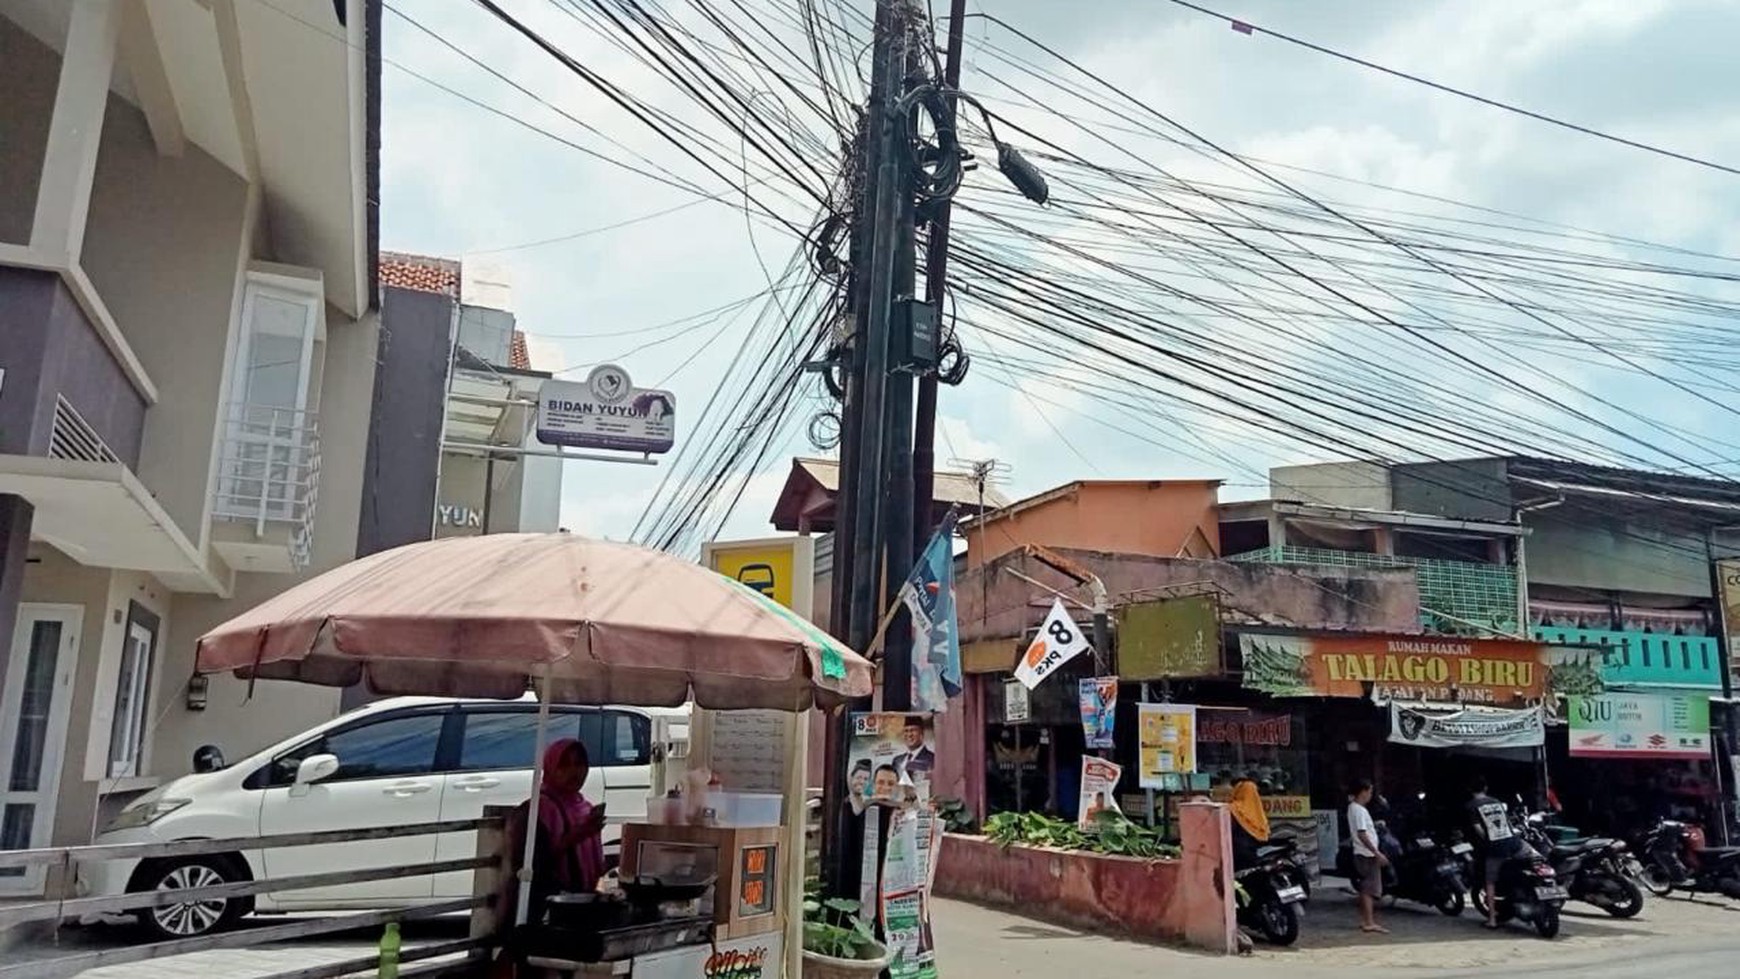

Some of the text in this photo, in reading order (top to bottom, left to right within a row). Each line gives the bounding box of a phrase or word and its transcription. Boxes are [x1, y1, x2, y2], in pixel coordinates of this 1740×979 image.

[547, 400, 593, 414] BIDAN
[597, 404, 648, 419] YUYUN
[1388, 641, 1472, 655] RUMAH MAKAN
[1322, 653, 1534, 687] TALAGO BIRU
[1440, 687, 1494, 702] PDANG
[857, 718, 865, 731] 8
[1197, 720, 1240, 743] AGO
[1262, 798, 1303, 813] DANG
